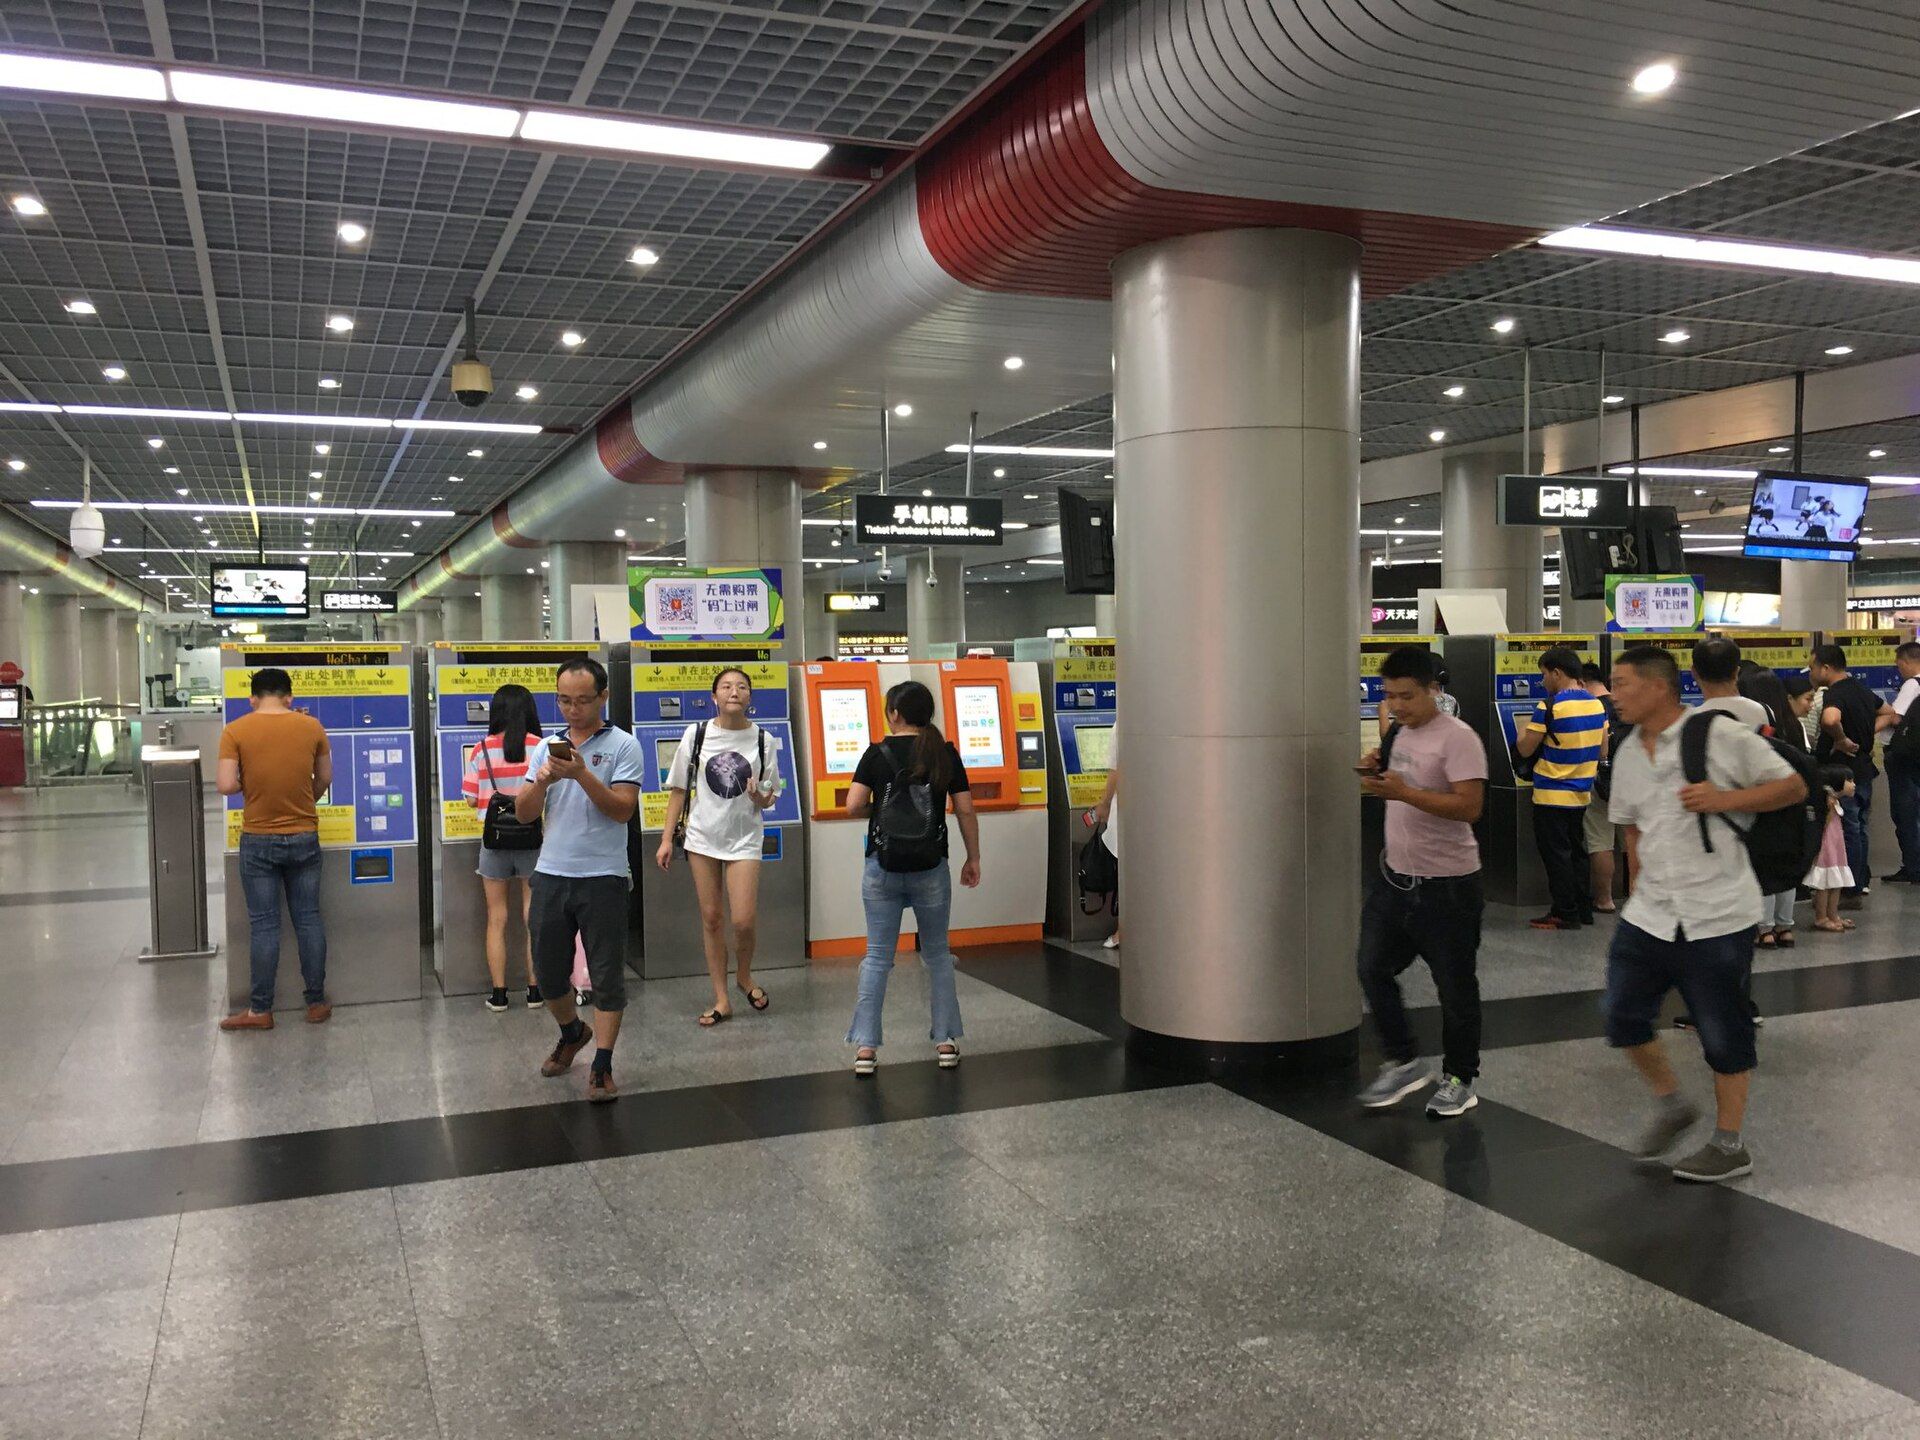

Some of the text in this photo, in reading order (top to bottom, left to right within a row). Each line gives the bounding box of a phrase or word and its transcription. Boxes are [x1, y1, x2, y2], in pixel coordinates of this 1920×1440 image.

[893, 504, 969, 525] 手机购票
[865, 525, 995, 537] Ticket Purchase via Mobile Phone
[705, 583, 758, 596] 无需购票
[326, 653, 368, 665] WeChat
